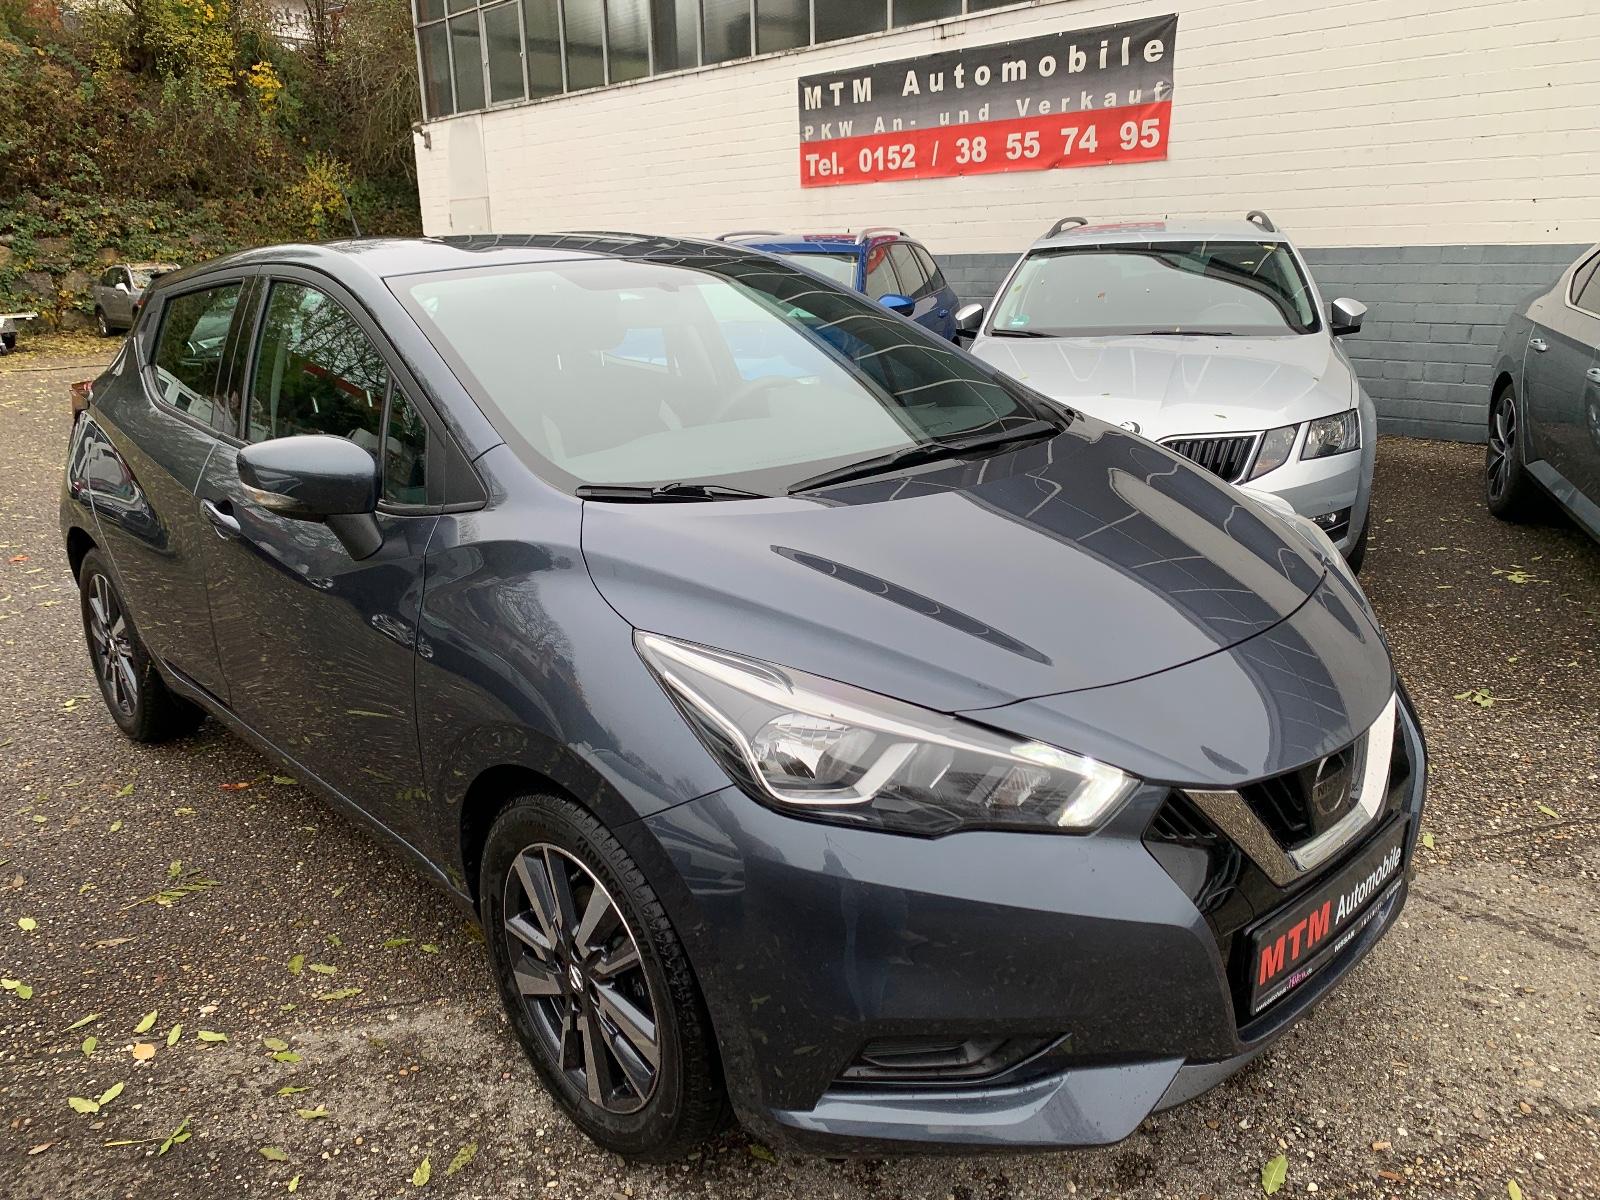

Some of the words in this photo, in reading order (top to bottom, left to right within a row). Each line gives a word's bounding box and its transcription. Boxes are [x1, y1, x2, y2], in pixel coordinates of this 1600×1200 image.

[804, 77, 872, 110] MTM
[901, 37, 1164, 96] Automobile
[803, 120, 853, 141] PKW
[873, 116, 916, 134] An-
[940, 103, 990, 126] und
[1016, 81, 1164, 117] Verkauf
[805, 152, 844, 177] Tel.
[858, 143, 916, 173] 0152
[931, 140, 939, 166] /
[955, 136, 987, 164] 38
[1006, 131, 1040, 160] 55
[1060, 125, 1098, 155] 74
[1119, 118, 1161, 151] 95
[1259, 900, 1331, 986] MTM
[1335, 845, 1402, 926] Automobile
